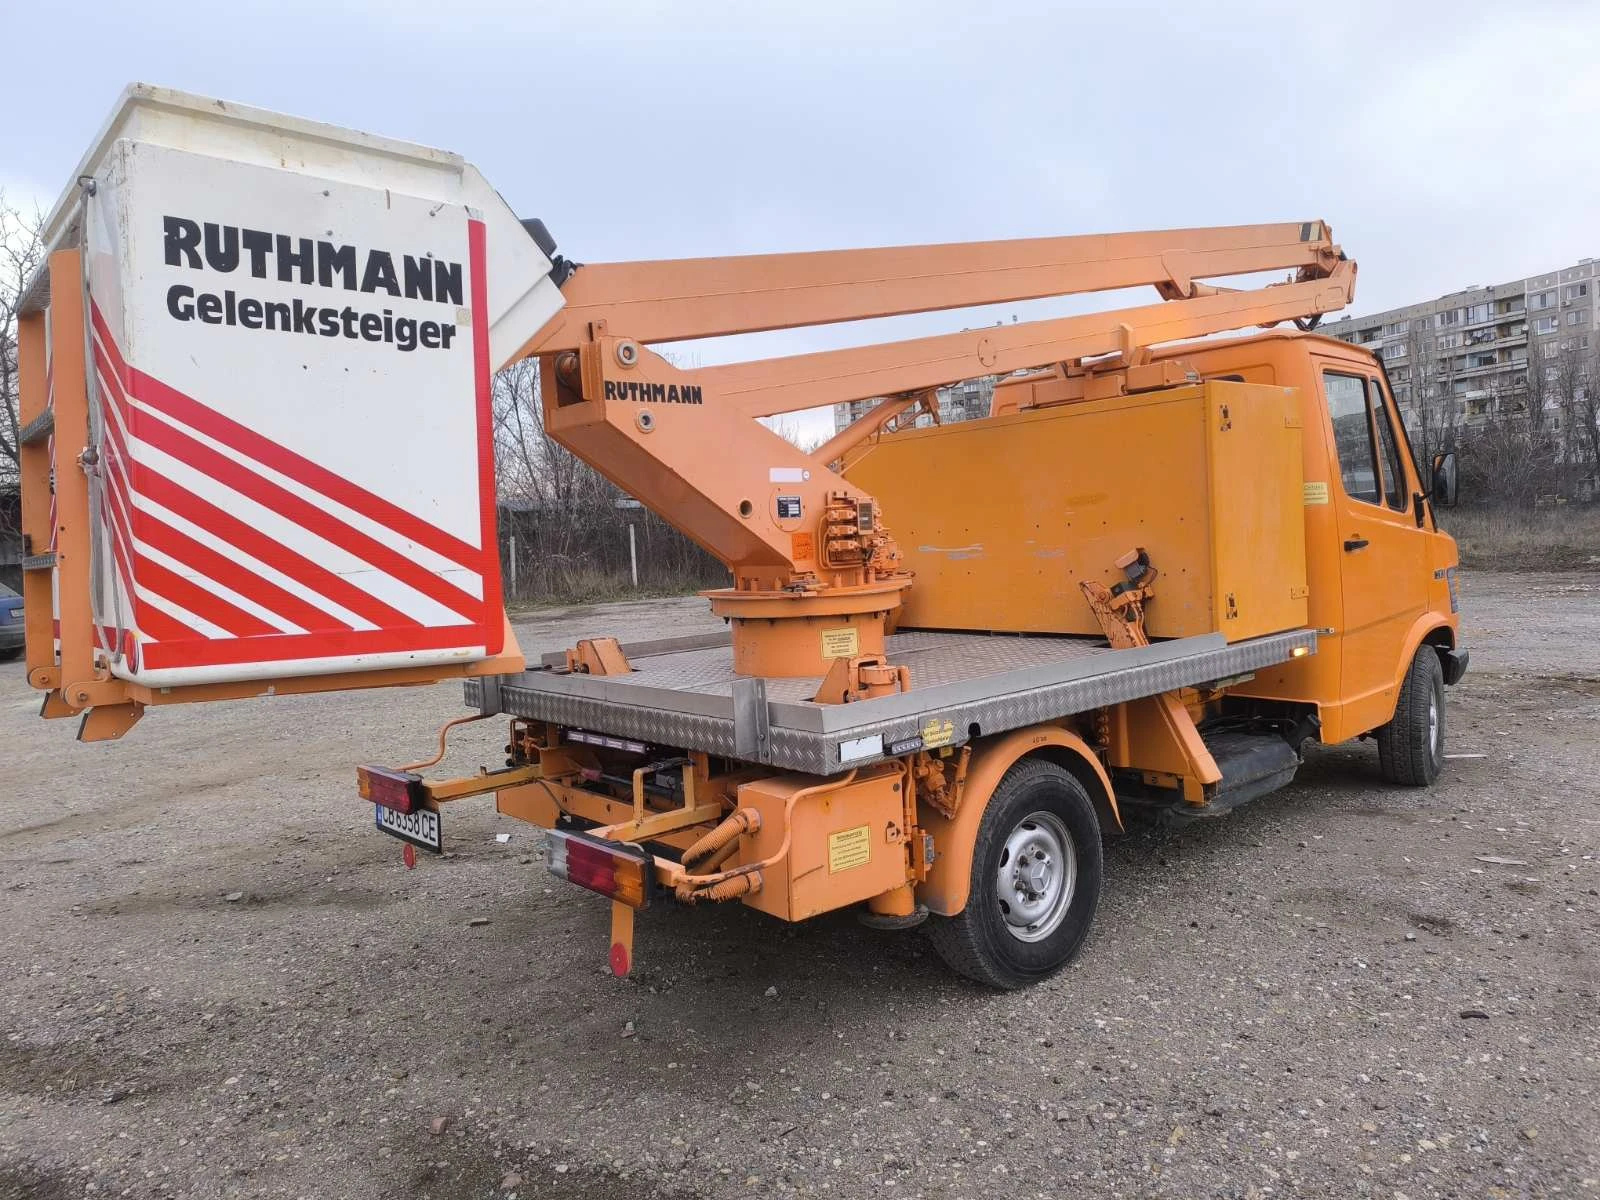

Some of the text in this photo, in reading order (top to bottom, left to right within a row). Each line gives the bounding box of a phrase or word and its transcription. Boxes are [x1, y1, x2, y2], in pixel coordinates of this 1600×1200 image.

[163, 216, 462, 304] RUTHMANN
[167, 285, 456, 351] Gelenksteiger
[605, 380, 702, 404] RUTHMANN
[422, 814, 436, 841] CE
